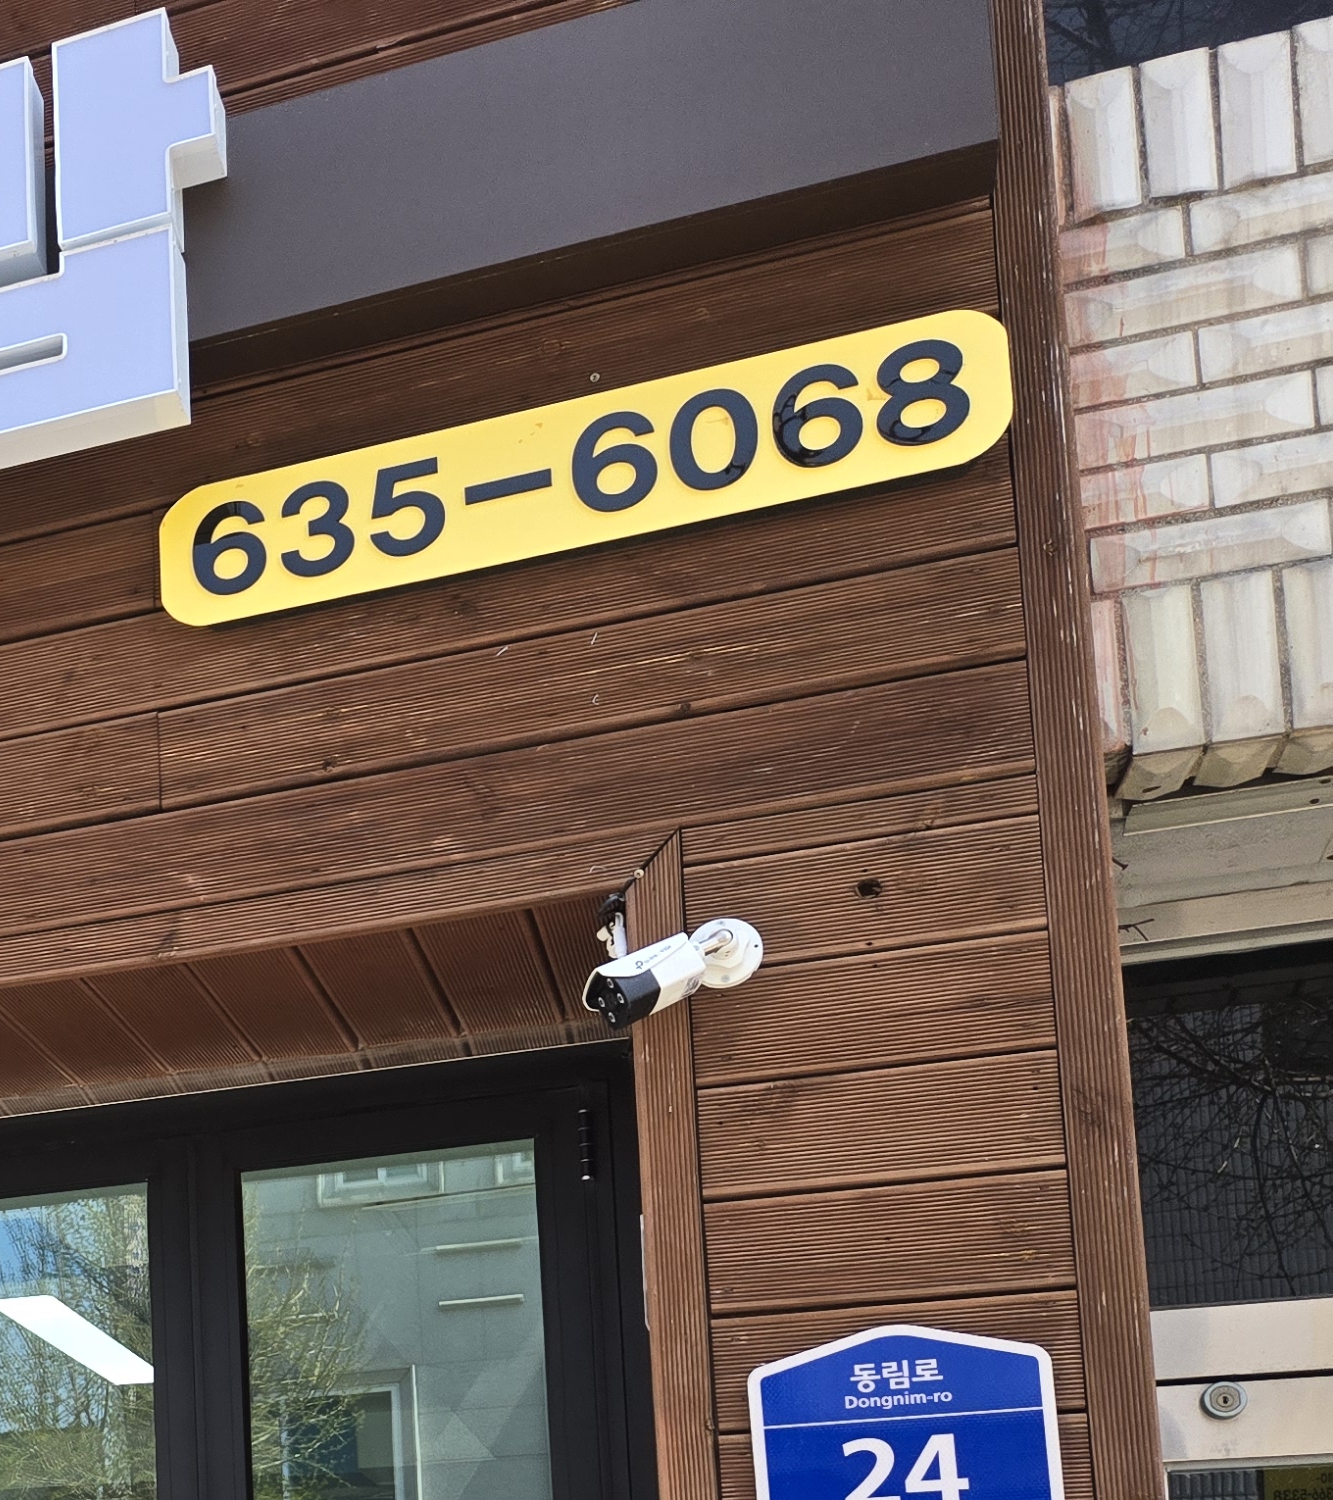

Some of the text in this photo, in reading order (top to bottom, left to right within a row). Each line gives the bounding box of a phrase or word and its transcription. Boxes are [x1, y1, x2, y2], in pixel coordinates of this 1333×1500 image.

[190, 336, 973, 597] 635-6068
[849, 1357, 945, 1393] 동림로
[844, 1389, 953, 1410] Dongnim-ro
